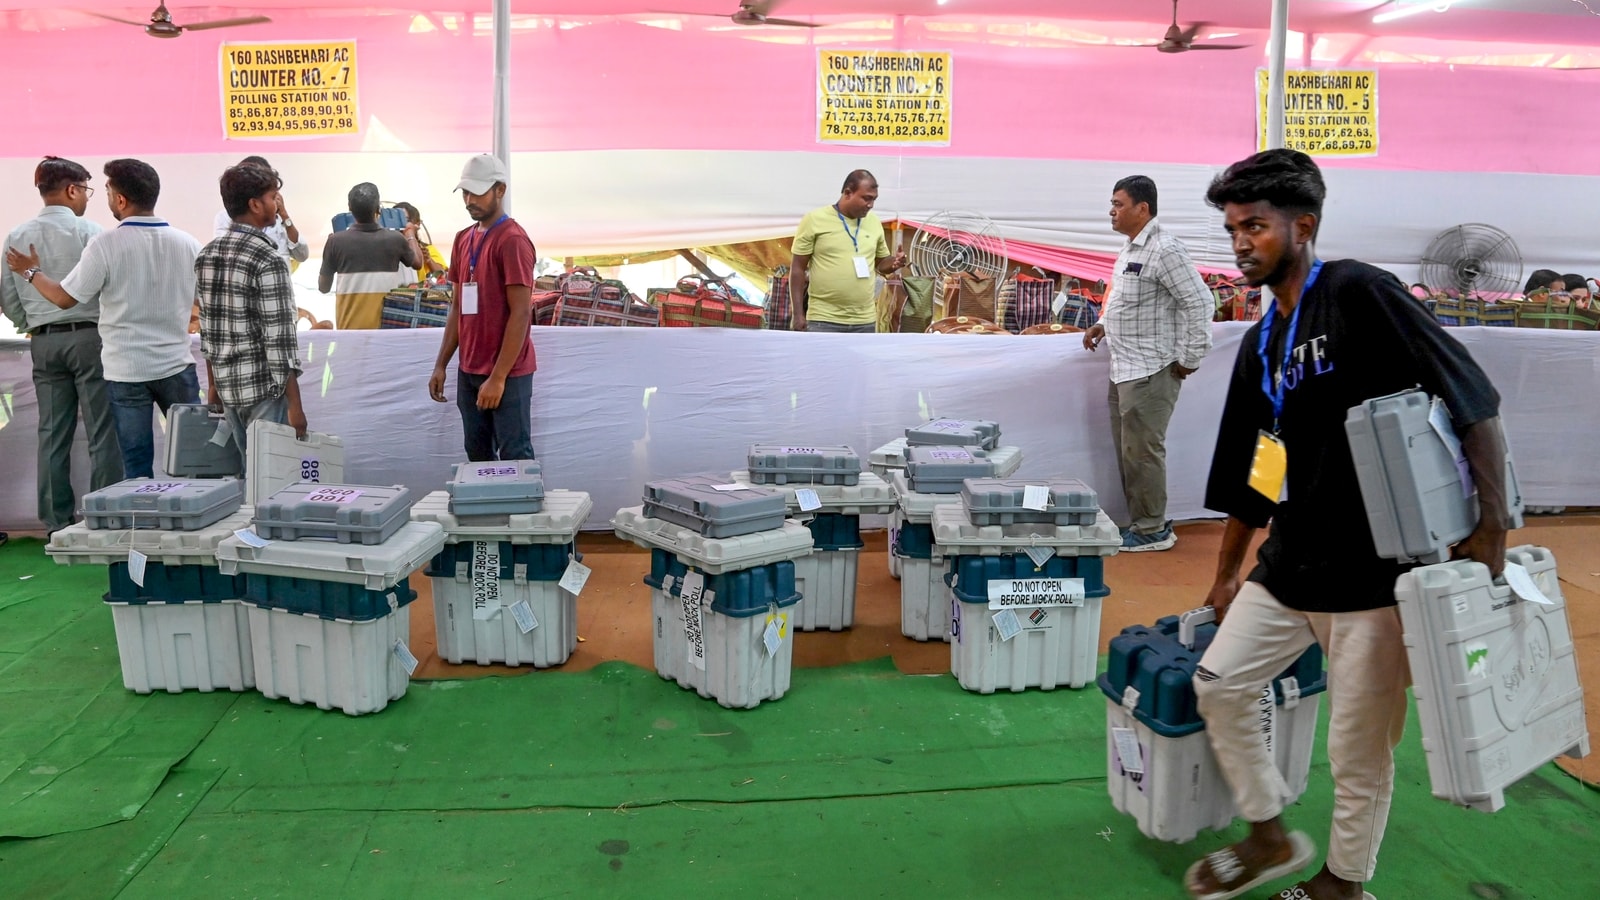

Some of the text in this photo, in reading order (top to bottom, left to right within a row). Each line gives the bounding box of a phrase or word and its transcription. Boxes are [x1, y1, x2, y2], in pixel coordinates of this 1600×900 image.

[230, 47, 349, 64] 160 RASHBEHARI AC
[828, 56, 943, 72] 160 RASHBEHARI AC
[230, 69, 296, 88] COUNTER
[302, 67, 326, 86] NO.
[342, 67, 350, 85] 7
[826, 74, 892, 93] COUNTER
[896, 75, 919, 94] NO.
[935, 76, 944, 94] 6
[1288, 75, 1369, 89] RASHBEHARI AC
[230, 91, 351, 104] POLLING STATION NO.
[826, 98, 944, 110] POLLING STATION NO.
[1284, 93, 1322, 111] UNTER
[1327, 93, 1348, 110] NO.
[1362, 94, 1370, 110] 5
[1285, 116, 1370, 125] LING STATION NO.
[1286, 128, 1373, 138] 8,59,60,61,62,63,
[1285, 140, 1372, 151] 5,66,67,68,69,70
[301, 460, 310, 479] 60
[310, 495, 346, 503] 160
[474, 541, 487, 609] BEFORE MOCK POLL
[487, 554, 498, 601] DO NOT OPEN
[1012, 581, 1062, 593] DO NOT OPEN
[1000, 593, 1073, 606] BEFORE MOCK POLL
[682, 593, 695, 643] DO NOT OPEN
[690, 586, 703, 658] BEFORE MOCK POLL
